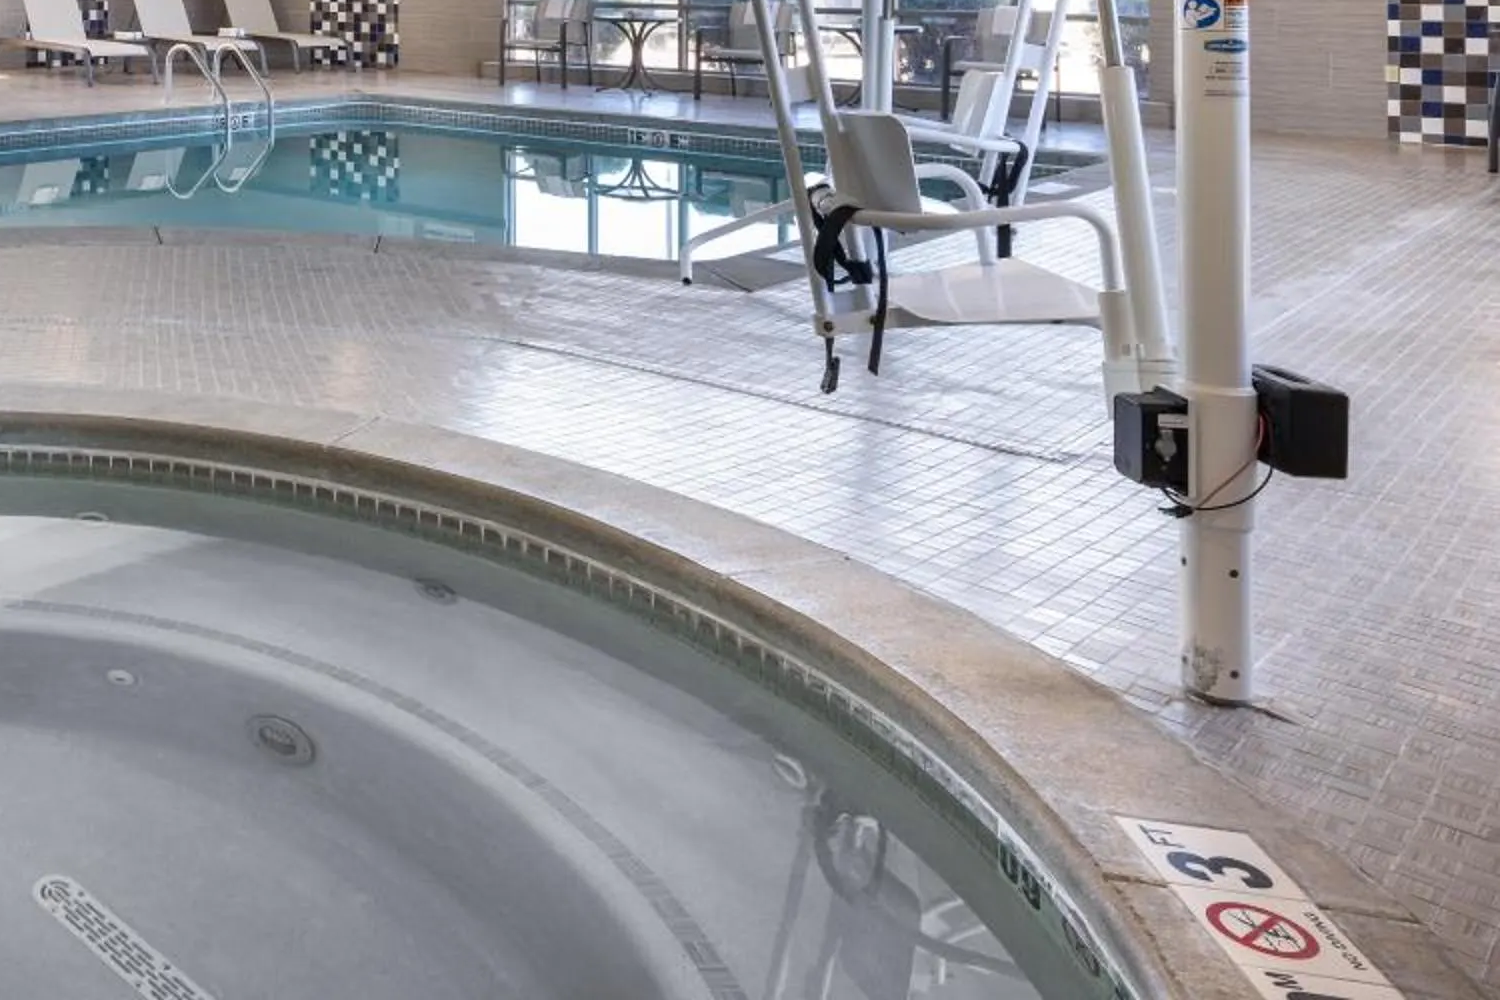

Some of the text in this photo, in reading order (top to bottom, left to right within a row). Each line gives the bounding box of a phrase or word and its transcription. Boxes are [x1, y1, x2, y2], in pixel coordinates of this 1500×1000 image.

[1137, 823, 1185, 849] FT
[1166, 850, 1274, 889] 3
[1264, 970, 1305, 991] M
